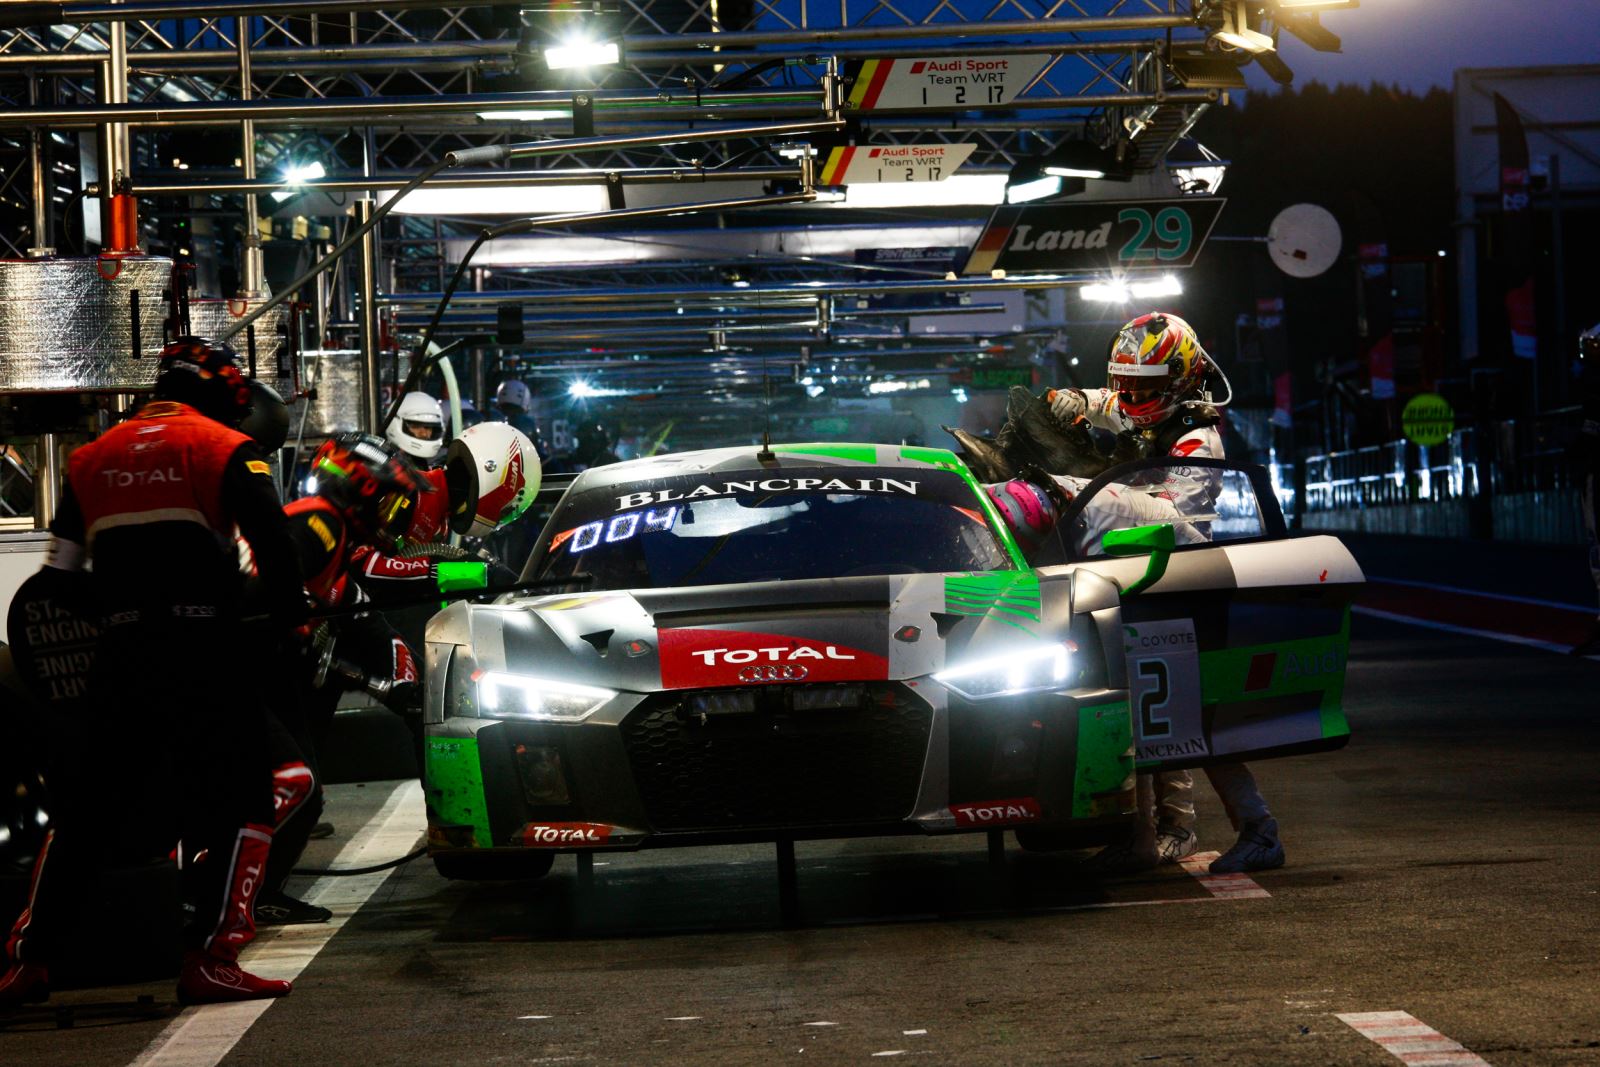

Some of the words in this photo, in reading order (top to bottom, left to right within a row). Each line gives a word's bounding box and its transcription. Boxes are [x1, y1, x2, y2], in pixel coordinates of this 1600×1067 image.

[928, 60, 962, 72] Audi
[966, 59, 1009, 72] Sport
[928, 74, 967, 85] Team
[972, 73, 1006, 84] WRT
[923, 87, 927, 105] 1
[955, 86, 966, 104] 2
[988, 85, 1004, 103] 17
[882, 148, 909, 156] Audi
[912, 147, 945, 157] Sport
[882, 158, 913, 167] Team
[916, 157, 943, 166] WRT
[906, 168, 914, 181] 2
[929, 167, 941, 181] 17
[1009, 220, 1113, 251] Land
[1117, 206, 1193, 261] 29
[101, 467, 184, 488] TOTAL
[615, 477, 921, 512] BLANCPAIN
[570, 504, 680, 553] 004
[384, 556, 430, 571] TOTAL
[1141, 632, 1195, 648] COYOTE
[34, 651, 95, 679] GINE
[692, 646, 856, 666] TOTAL
[1283, 643, 1344, 682] Audi
[1136, 657, 1172, 741] 2
[958, 805, 1036, 822] TOTAL
[533, 826, 600, 842] TOTAL
[228, 862, 262, 941] TOTAL
